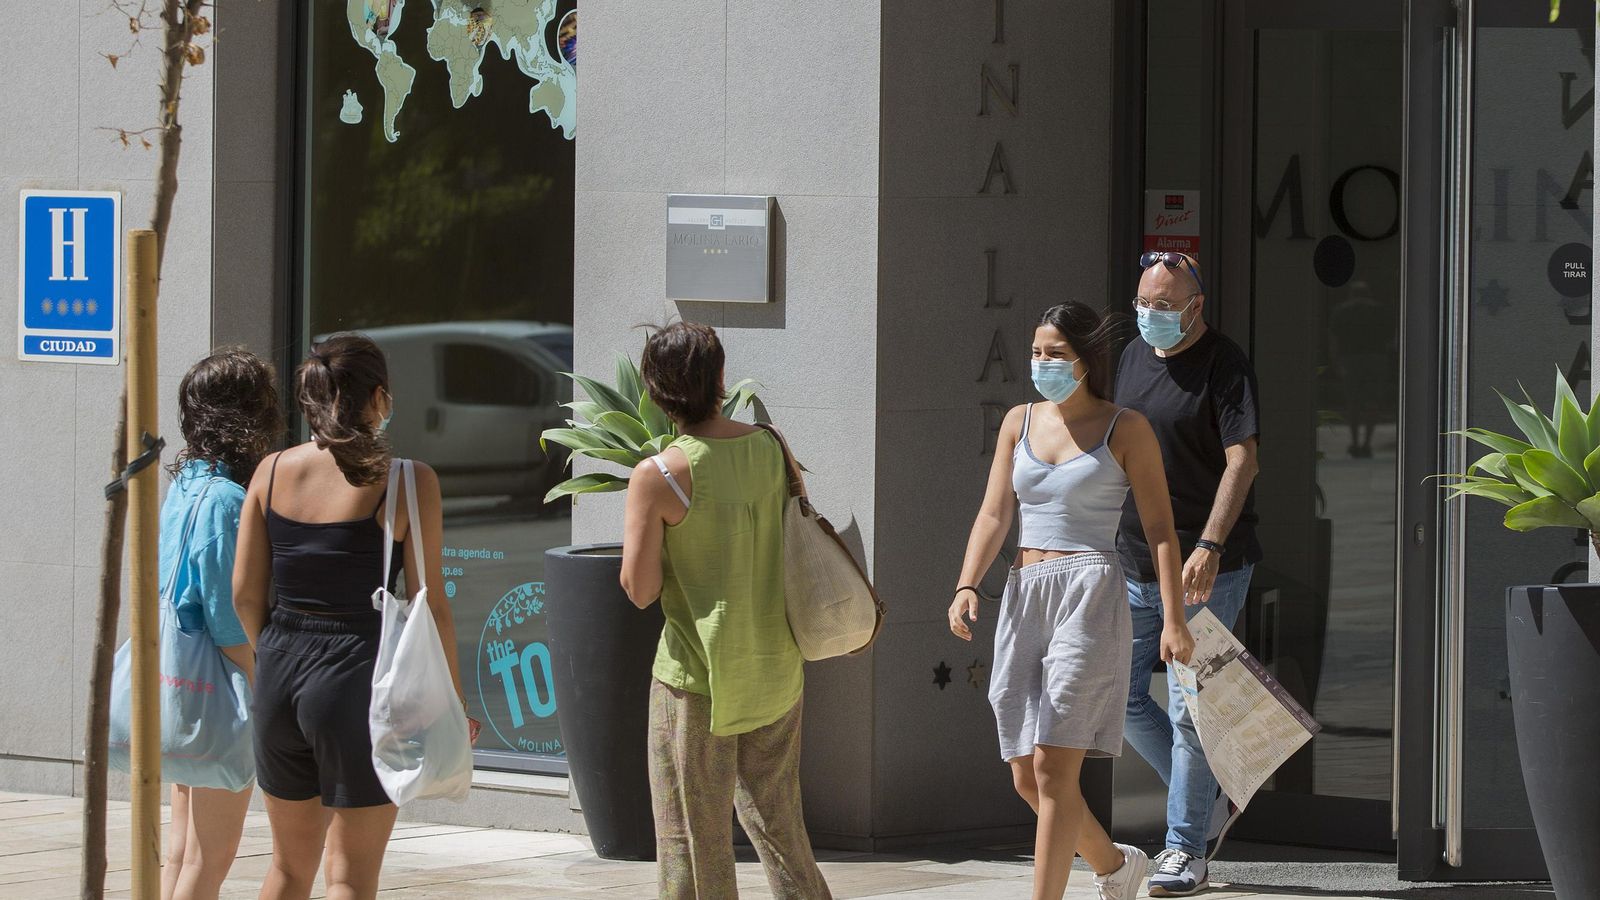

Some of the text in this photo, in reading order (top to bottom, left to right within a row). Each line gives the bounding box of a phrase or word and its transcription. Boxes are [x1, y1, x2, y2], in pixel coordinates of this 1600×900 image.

[48, 208, 89, 281] H
[672, 232, 759, 248] MOLINA LARIO
[1156, 237, 1191, 248] Alarma
[1564, 262, 1585, 270] PULL
[39, 340, 97, 353] CIUDAD
[441, 546, 504, 560] tra agenda en
[486, 638, 516, 664] the
[517, 735, 562, 753] MOLINA
